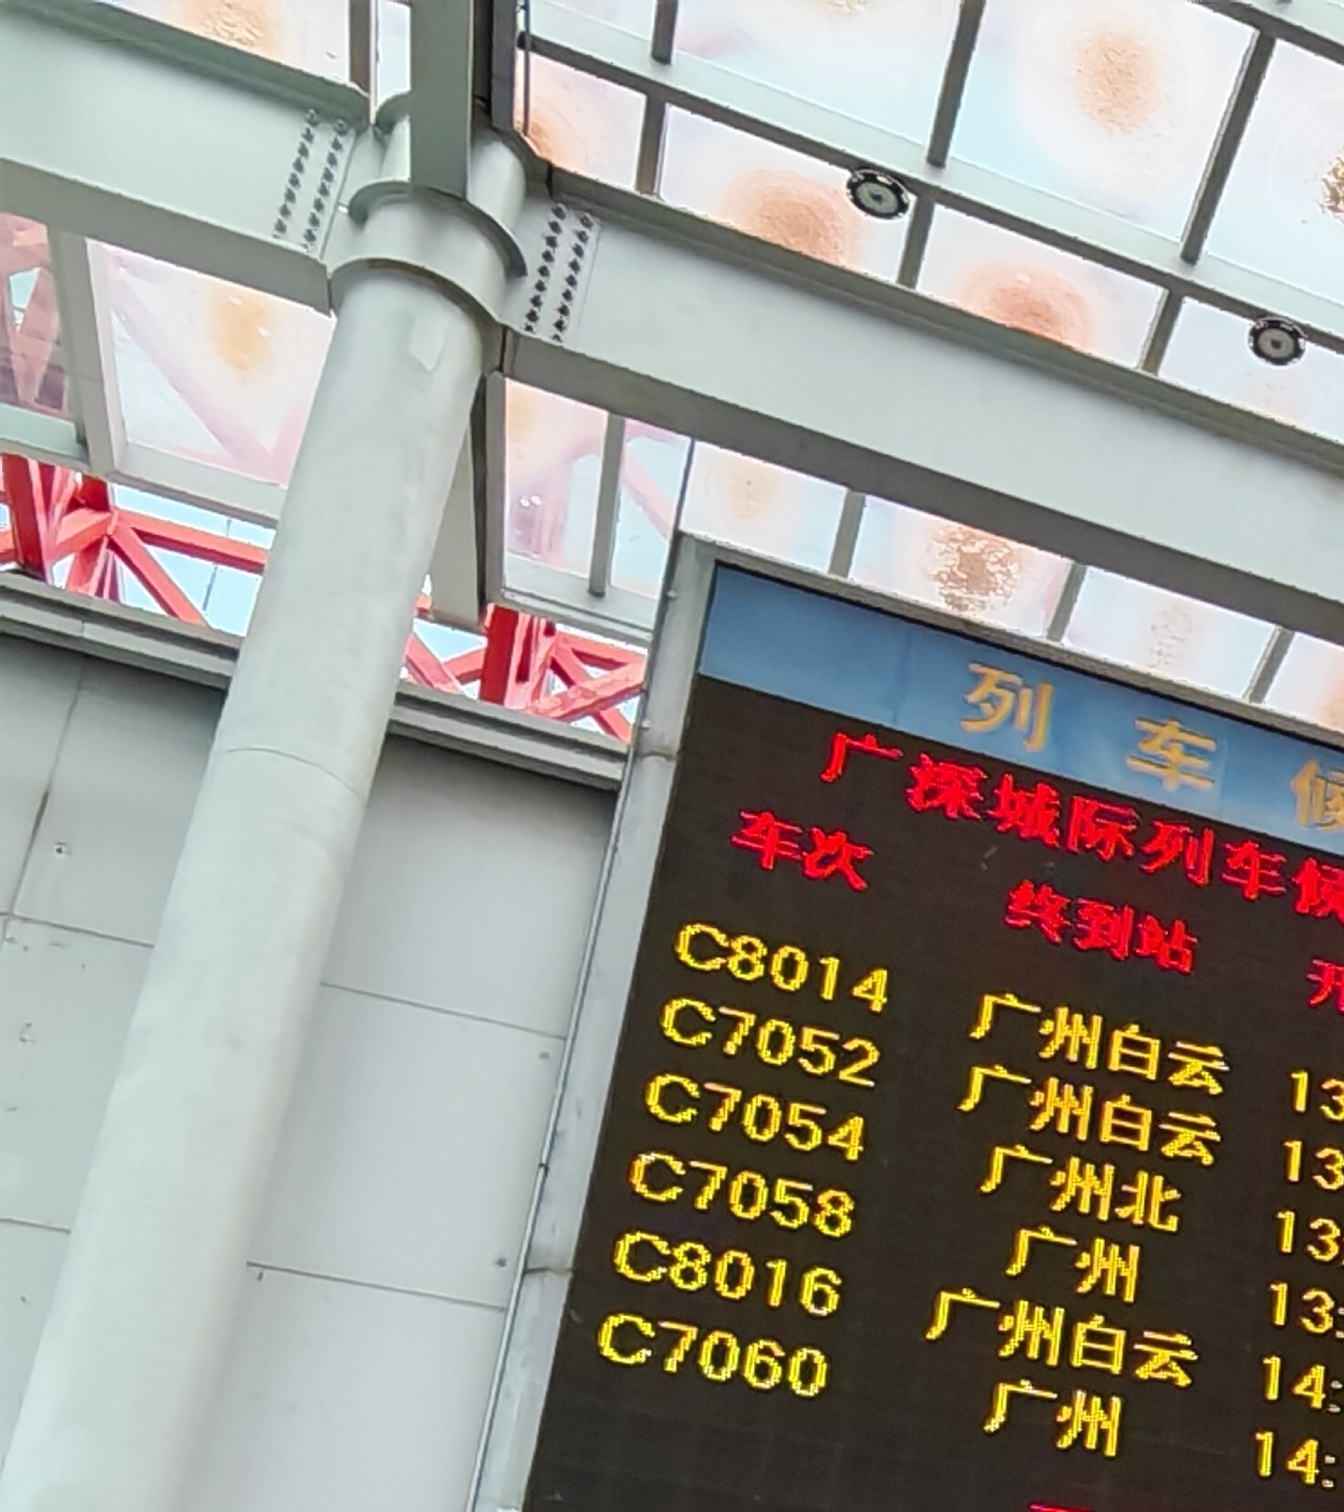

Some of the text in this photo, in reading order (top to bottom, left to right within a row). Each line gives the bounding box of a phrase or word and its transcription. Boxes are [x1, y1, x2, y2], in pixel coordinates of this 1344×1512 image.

[731, 810, 874, 892] 车次
[1005, 878, 1197, 975] 终到站
[660, 999, 880, 1086] C7052
[959, 1065, 1220, 1165] 广州白云
[675, 924, 889, 1013] C8014
[970, 994, 1229, 1094] 广州白云
[629, 1152, 855, 1237] C7058
[1007, 1226, 1140, 1302] 广州
[645, 1074, 864, 1160] C7054
[981, 1145, 1180, 1232] 广州北
[599, 1314, 827, 1396] C7060
[985, 1380, 1120, 1455] 广州
[614, 1232, 842, 1315] C8016
[927, 1287, 1198, 1385] 广州白云
